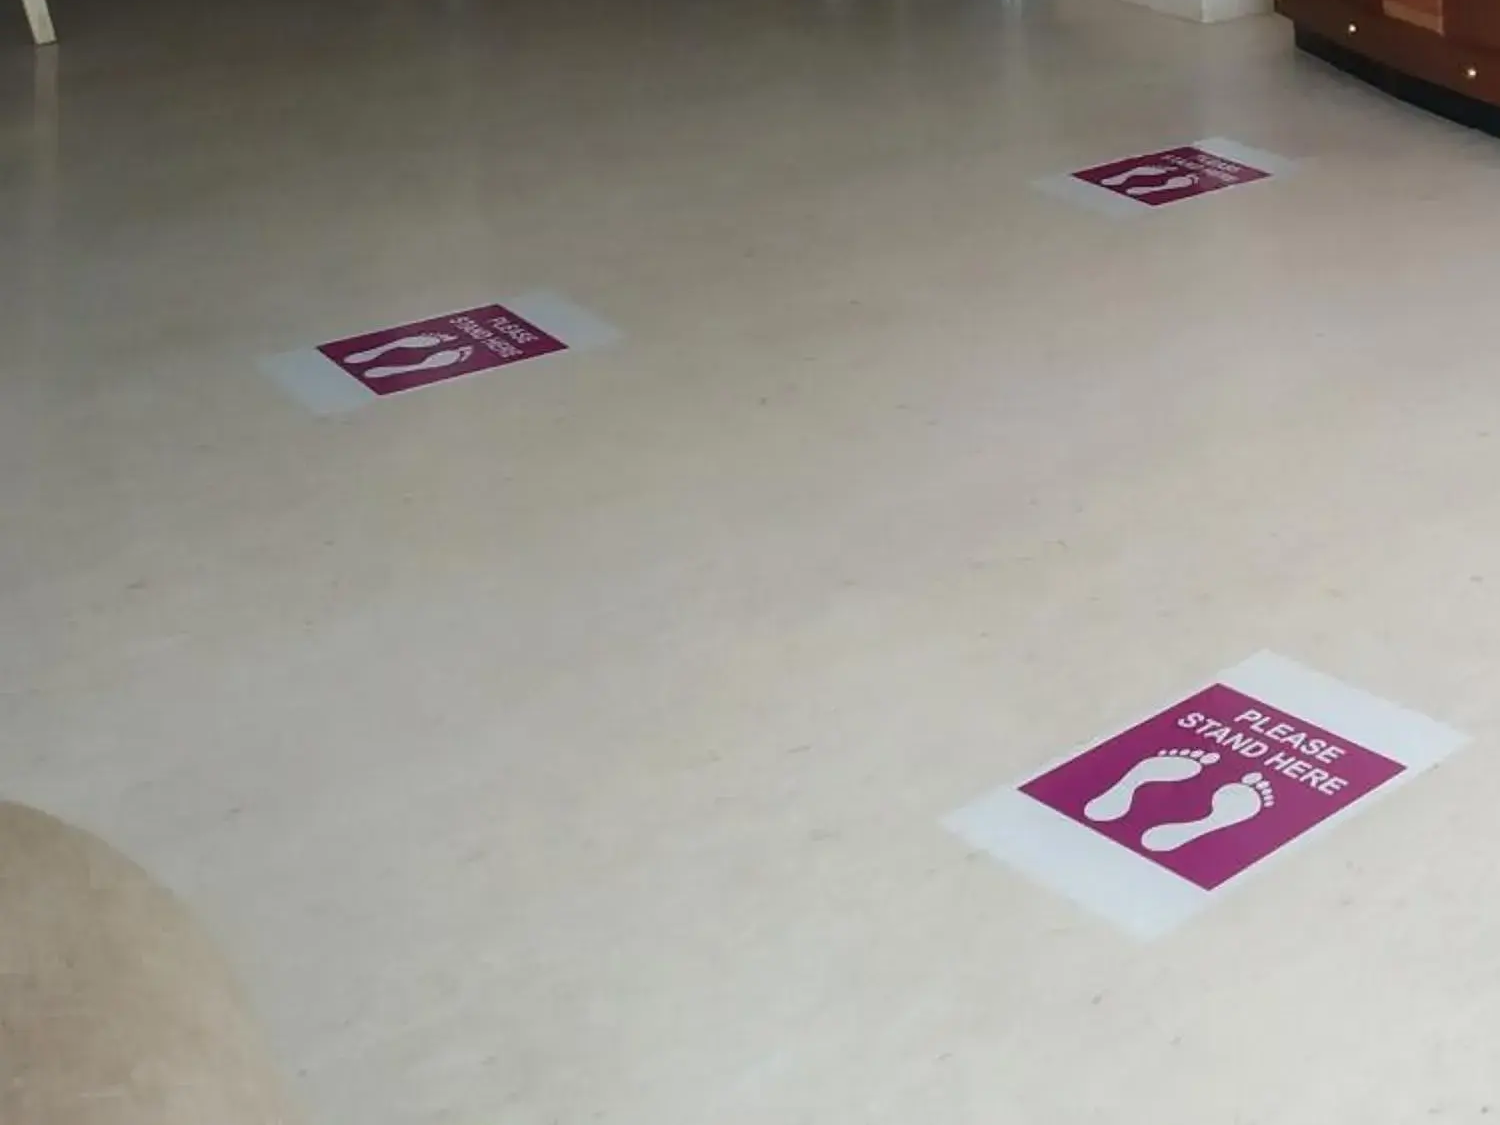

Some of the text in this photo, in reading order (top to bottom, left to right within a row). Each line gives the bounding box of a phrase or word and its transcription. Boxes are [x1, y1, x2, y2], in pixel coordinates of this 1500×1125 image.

[1177, 712, 1349, 796] STAND HERE
[1233, 709, 1347, 764] PLEASE
